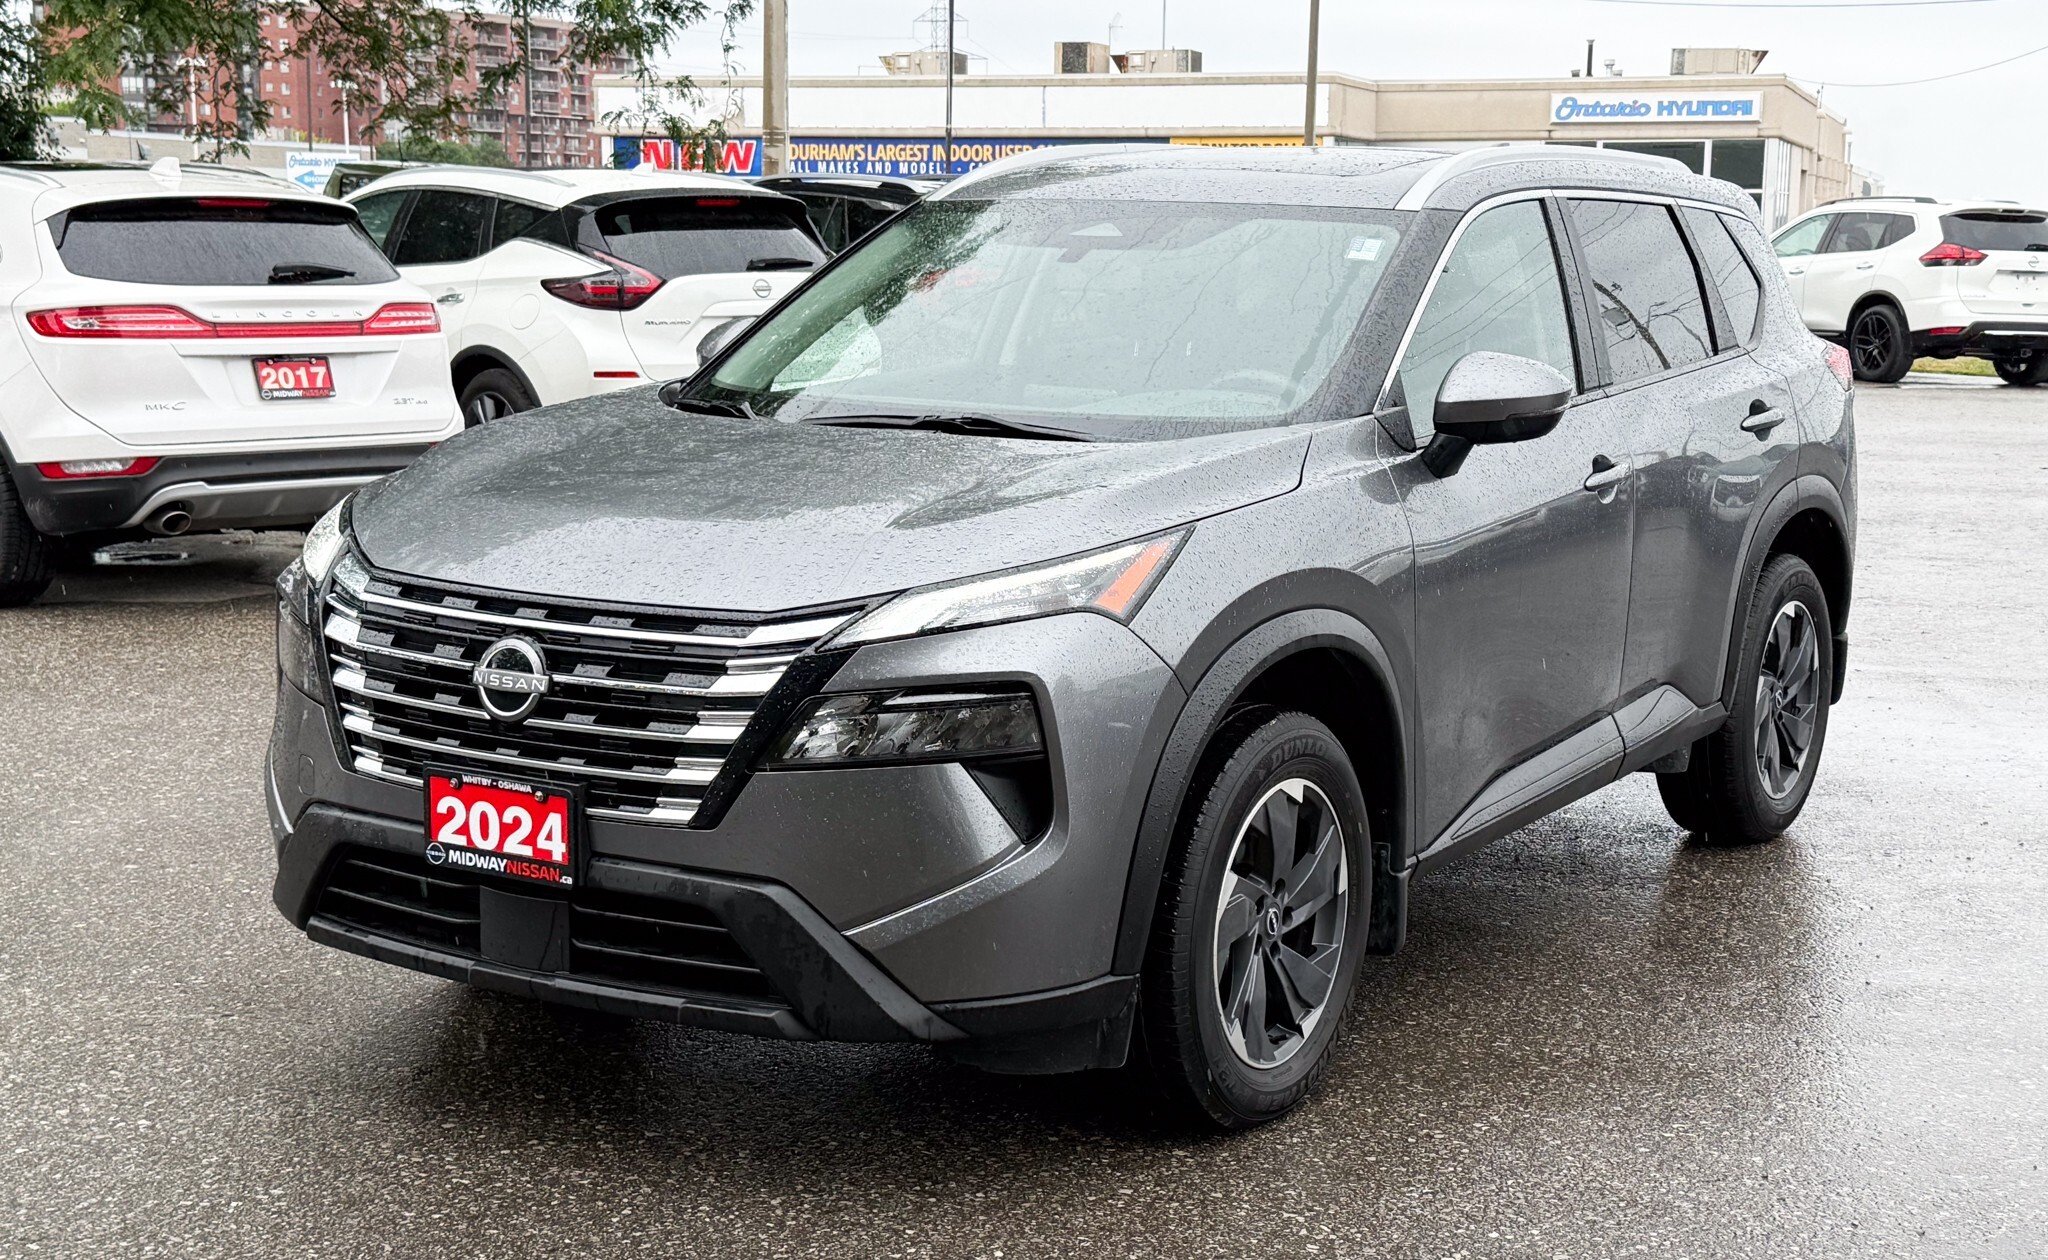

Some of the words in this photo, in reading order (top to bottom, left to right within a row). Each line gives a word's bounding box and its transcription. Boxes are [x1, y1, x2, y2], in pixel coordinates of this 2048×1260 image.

[1555, 96, 1651, 120] Ontario
[1657, 100, 1754, 117] HYUNDAI
[789, 143, 865, 161] DURHAM'S
[867, 144, 930, 162] LARGEST
[789, 161, 810, 173] ALL
[818, 161, 859, 174] MAKES
[866, 162, 891, 174] AND
[212, 310, 363, 319] LINCOLN
[261, 366, 327, 389] 2017
[145, 401, 187, 411] MKC
[473, 670, 546, 691] NISSAN
[462, 774, 492, 787] WHITBY
[498, 781, 532, 794] OSHAWA
[436, 796, 567, 862] 2024
